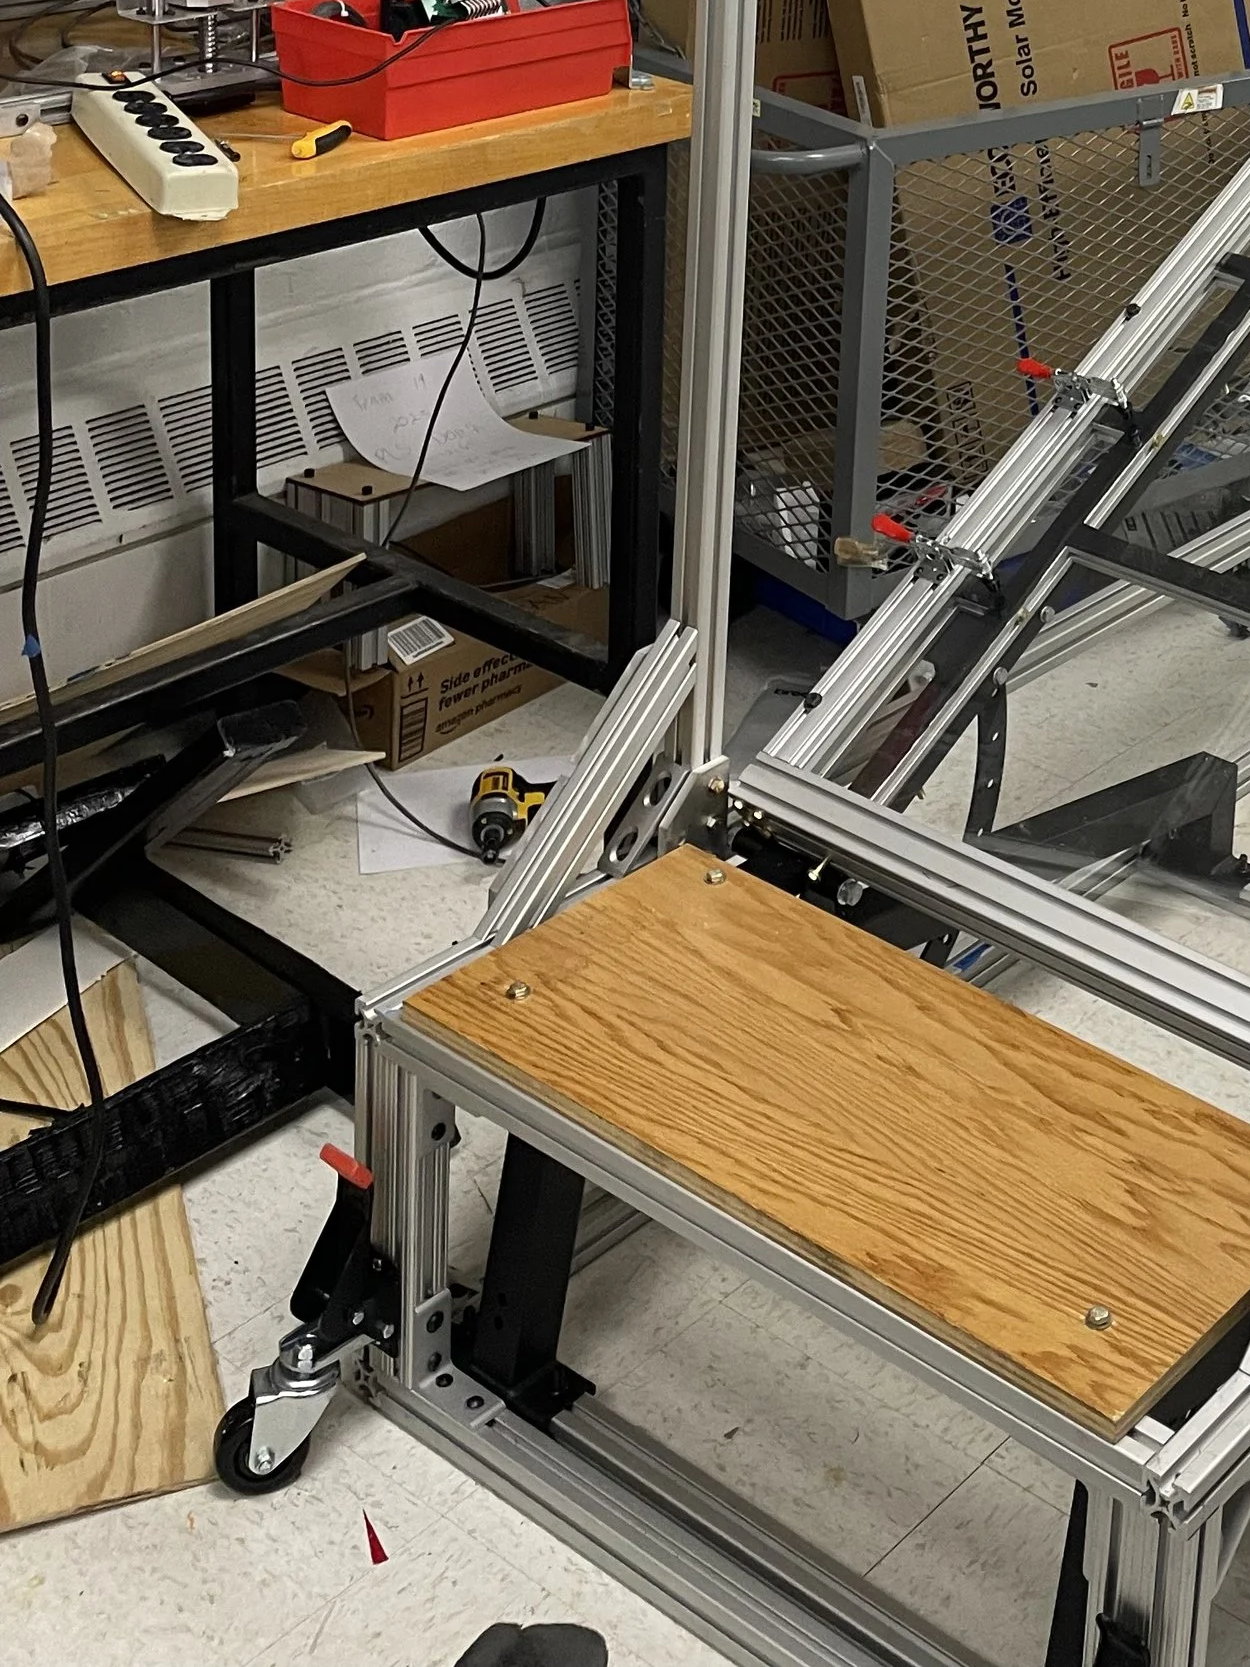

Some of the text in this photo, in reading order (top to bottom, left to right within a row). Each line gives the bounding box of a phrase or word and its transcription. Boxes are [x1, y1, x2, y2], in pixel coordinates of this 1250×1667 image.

[1012, 34, 1038, 97] Solar
[438, 684, 483, 712] fewer
[440, 671, 470, 694] Side
[435, 684, 523, 733] amazon pharmacy
